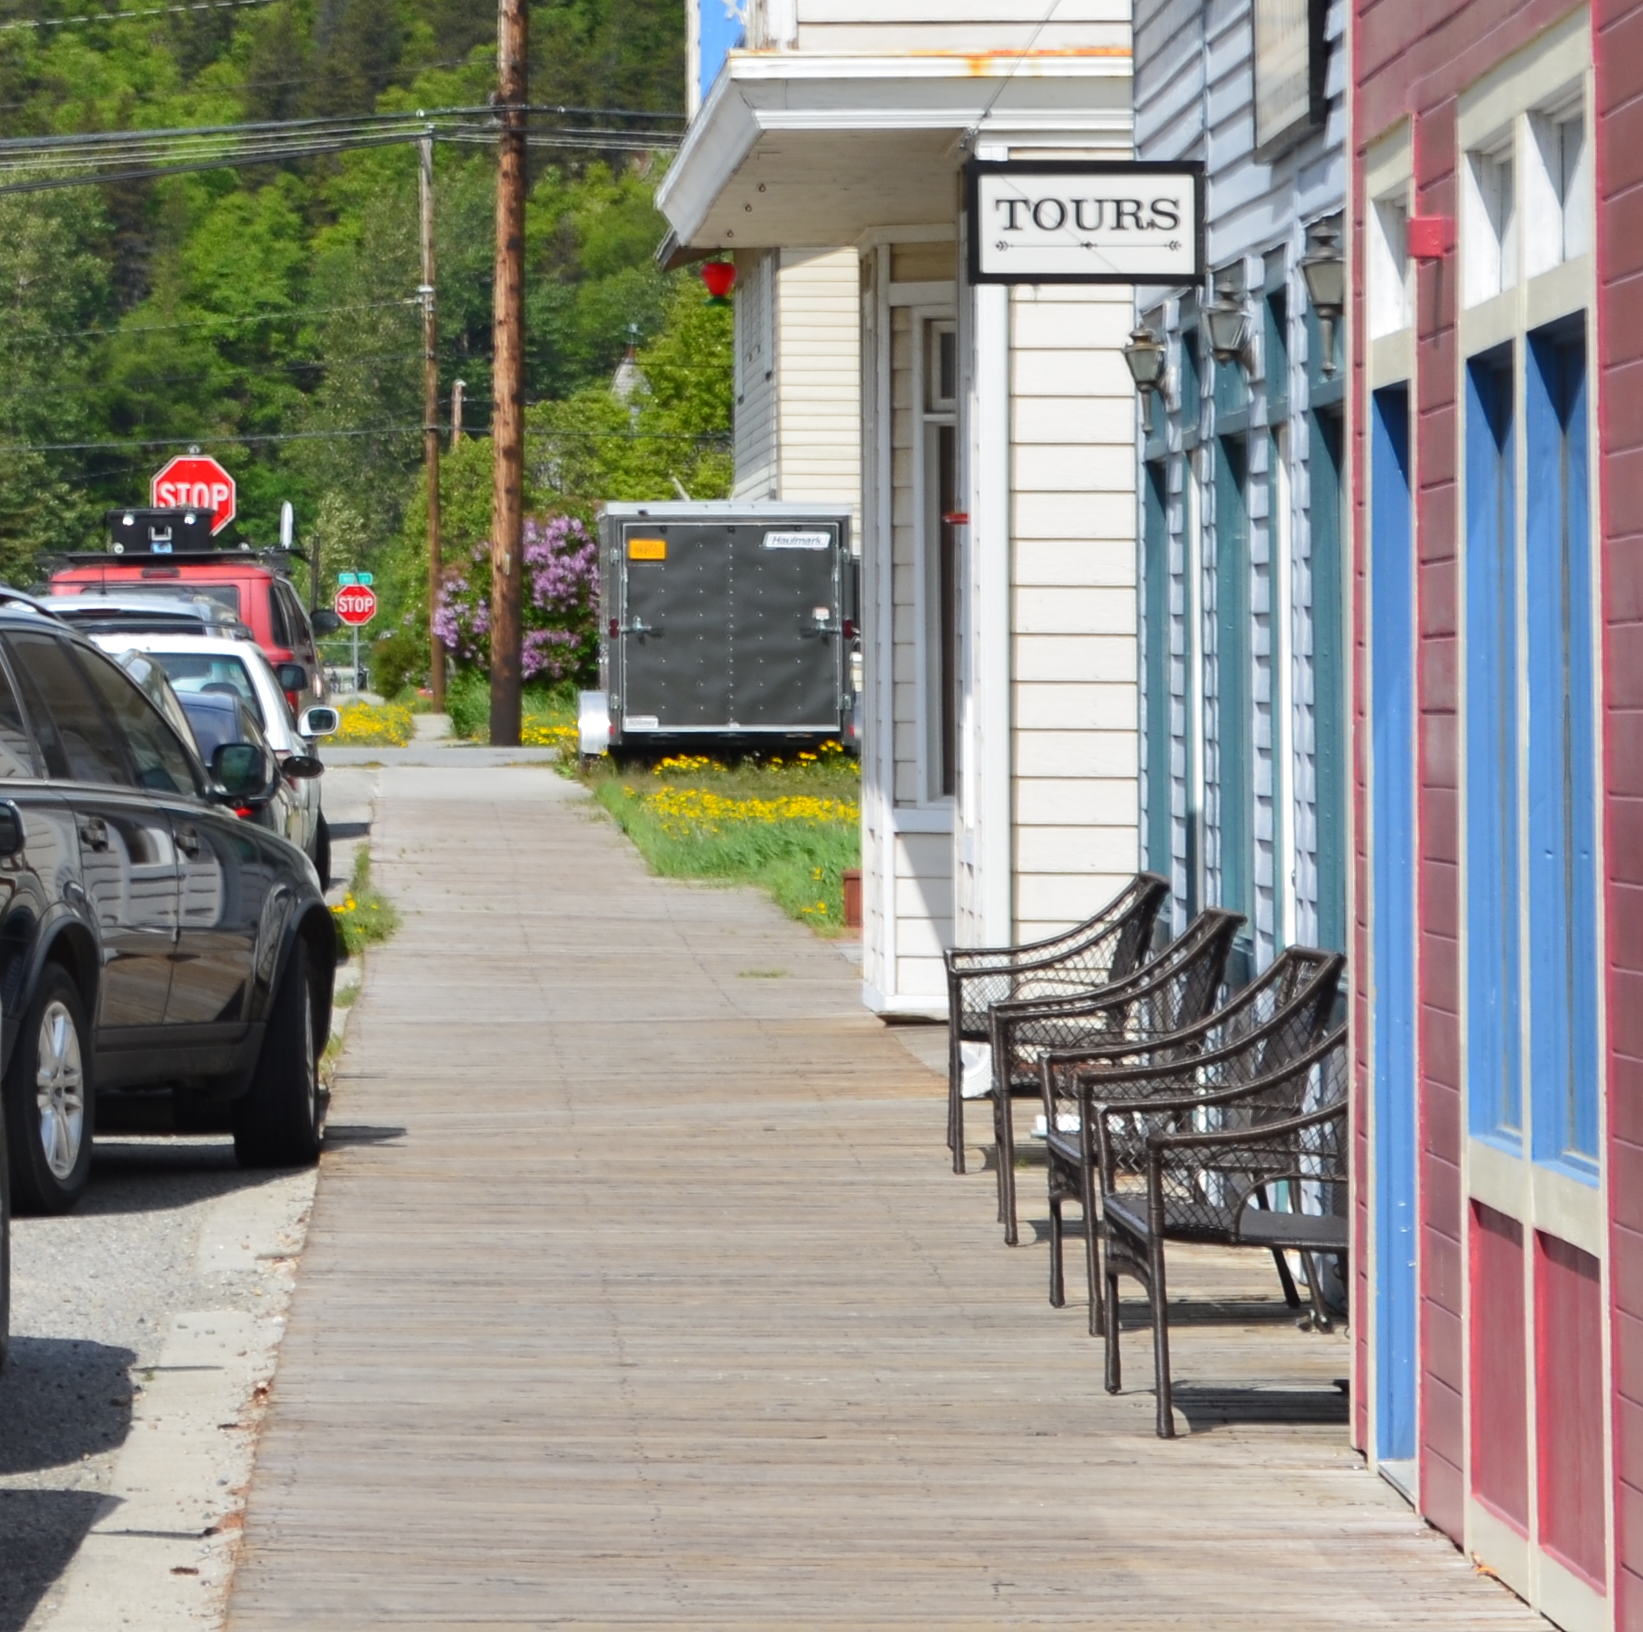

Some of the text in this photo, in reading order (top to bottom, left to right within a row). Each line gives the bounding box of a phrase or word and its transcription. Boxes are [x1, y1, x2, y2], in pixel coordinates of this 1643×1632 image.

[995, 197, 1181, 231] TOURS
[158, 480, 229, 512] STOP
[771, 535, 823, 546] Haulmark
[338, 595, 374, 613] STOP
